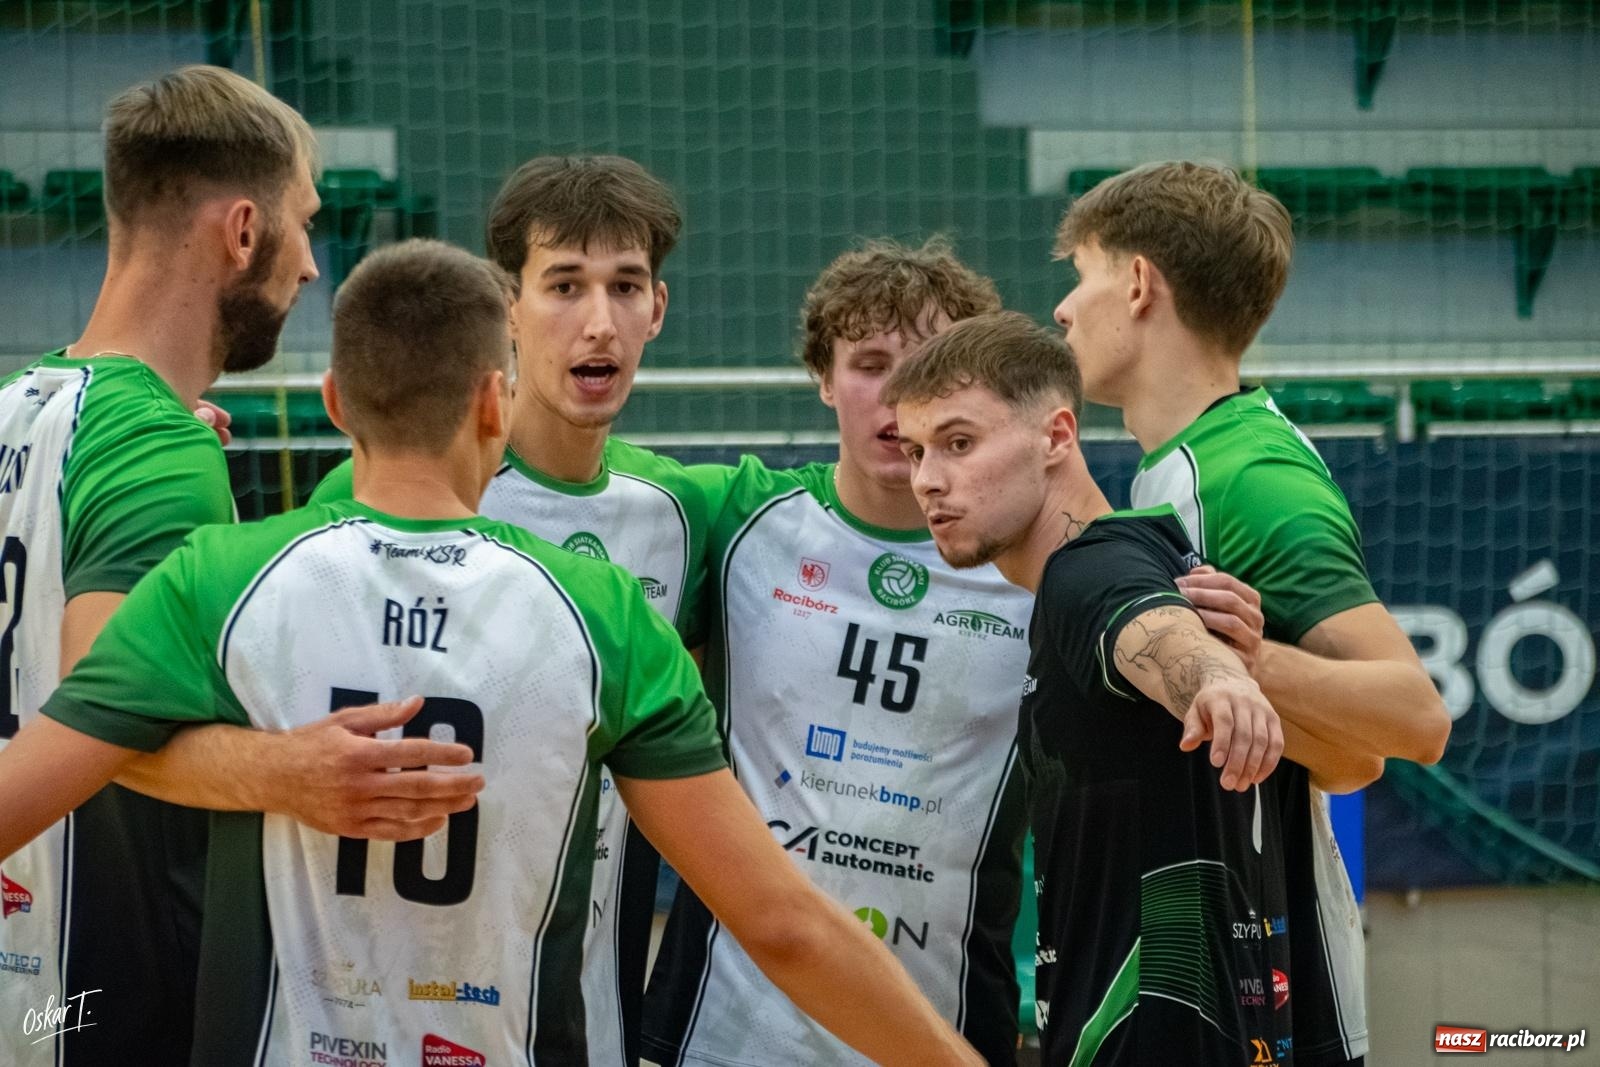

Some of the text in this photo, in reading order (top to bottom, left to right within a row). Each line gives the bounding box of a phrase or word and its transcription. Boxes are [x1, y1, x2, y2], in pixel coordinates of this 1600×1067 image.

[645, 584, 668, 600] TEAM
[772, 587, 839, 615] Racibórz
[381, 596, 450, 654] RÓŻ
[1388, 558, 1597, 726] BÓ
[836, 622, 929, 714] 45
[850, 751, 904, 769] porozumienia
[852, 739, 934, 763] budujemy możliwości
[800, 770, 943, 815] kierunekbmp.pl
[825, 829, 921, 860] CONCEPT
[821, 848, 935, 884] automatic
[407, 976, 501, 1007] instal-tech
[310, 1031, 387, 1061] PIVEXIN
[425, 1045, 453, 1054] Radio
[425, 1055, 483, 1067] VANESSA
